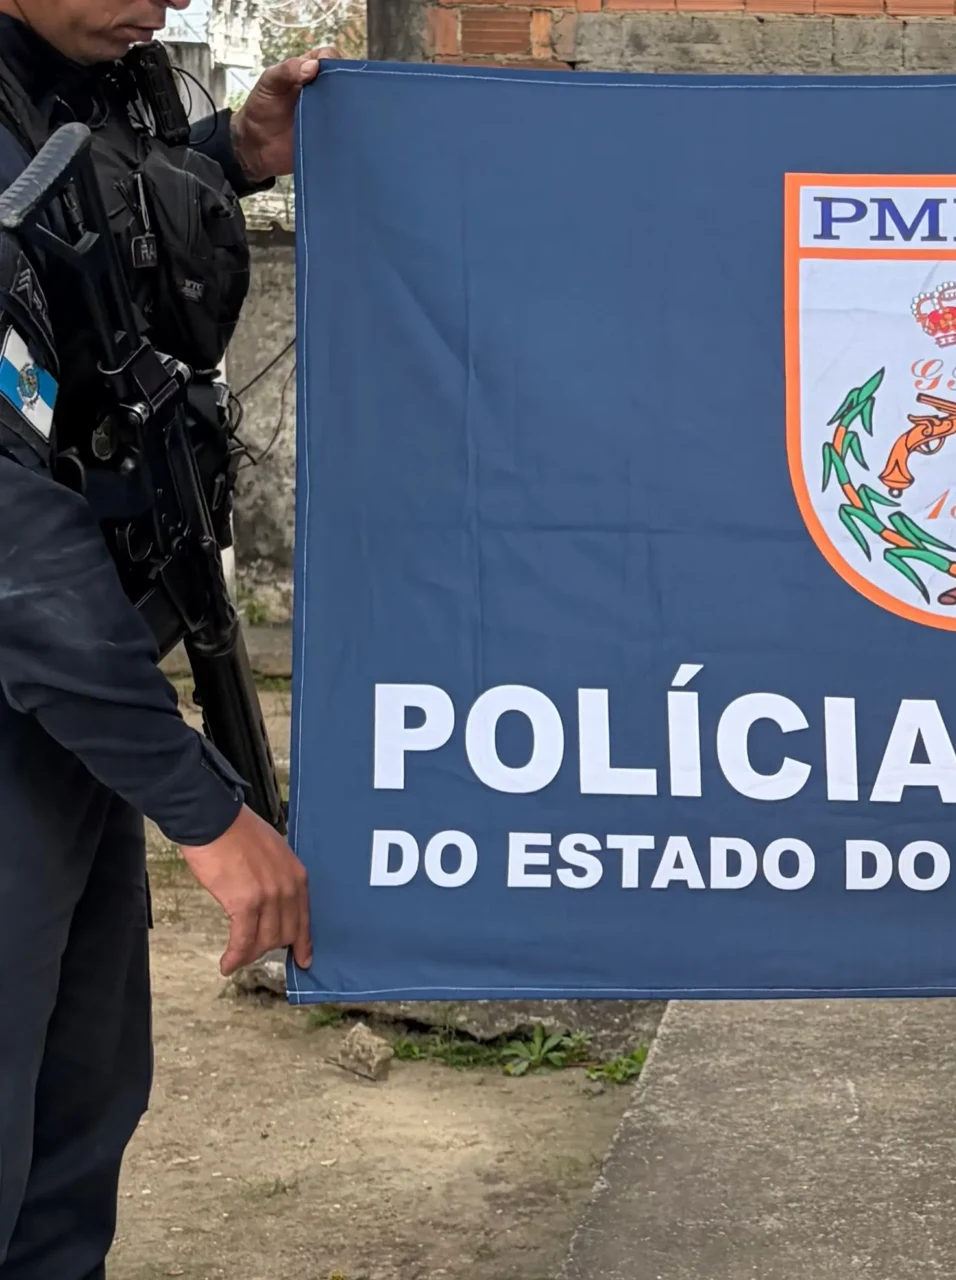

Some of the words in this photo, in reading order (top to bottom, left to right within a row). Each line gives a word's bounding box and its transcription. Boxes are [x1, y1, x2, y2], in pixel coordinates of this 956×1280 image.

[369, 829, 478, 888] DO
[507, 832, 816, 890] ESTADO
[845, 839, 951, 891] DO
